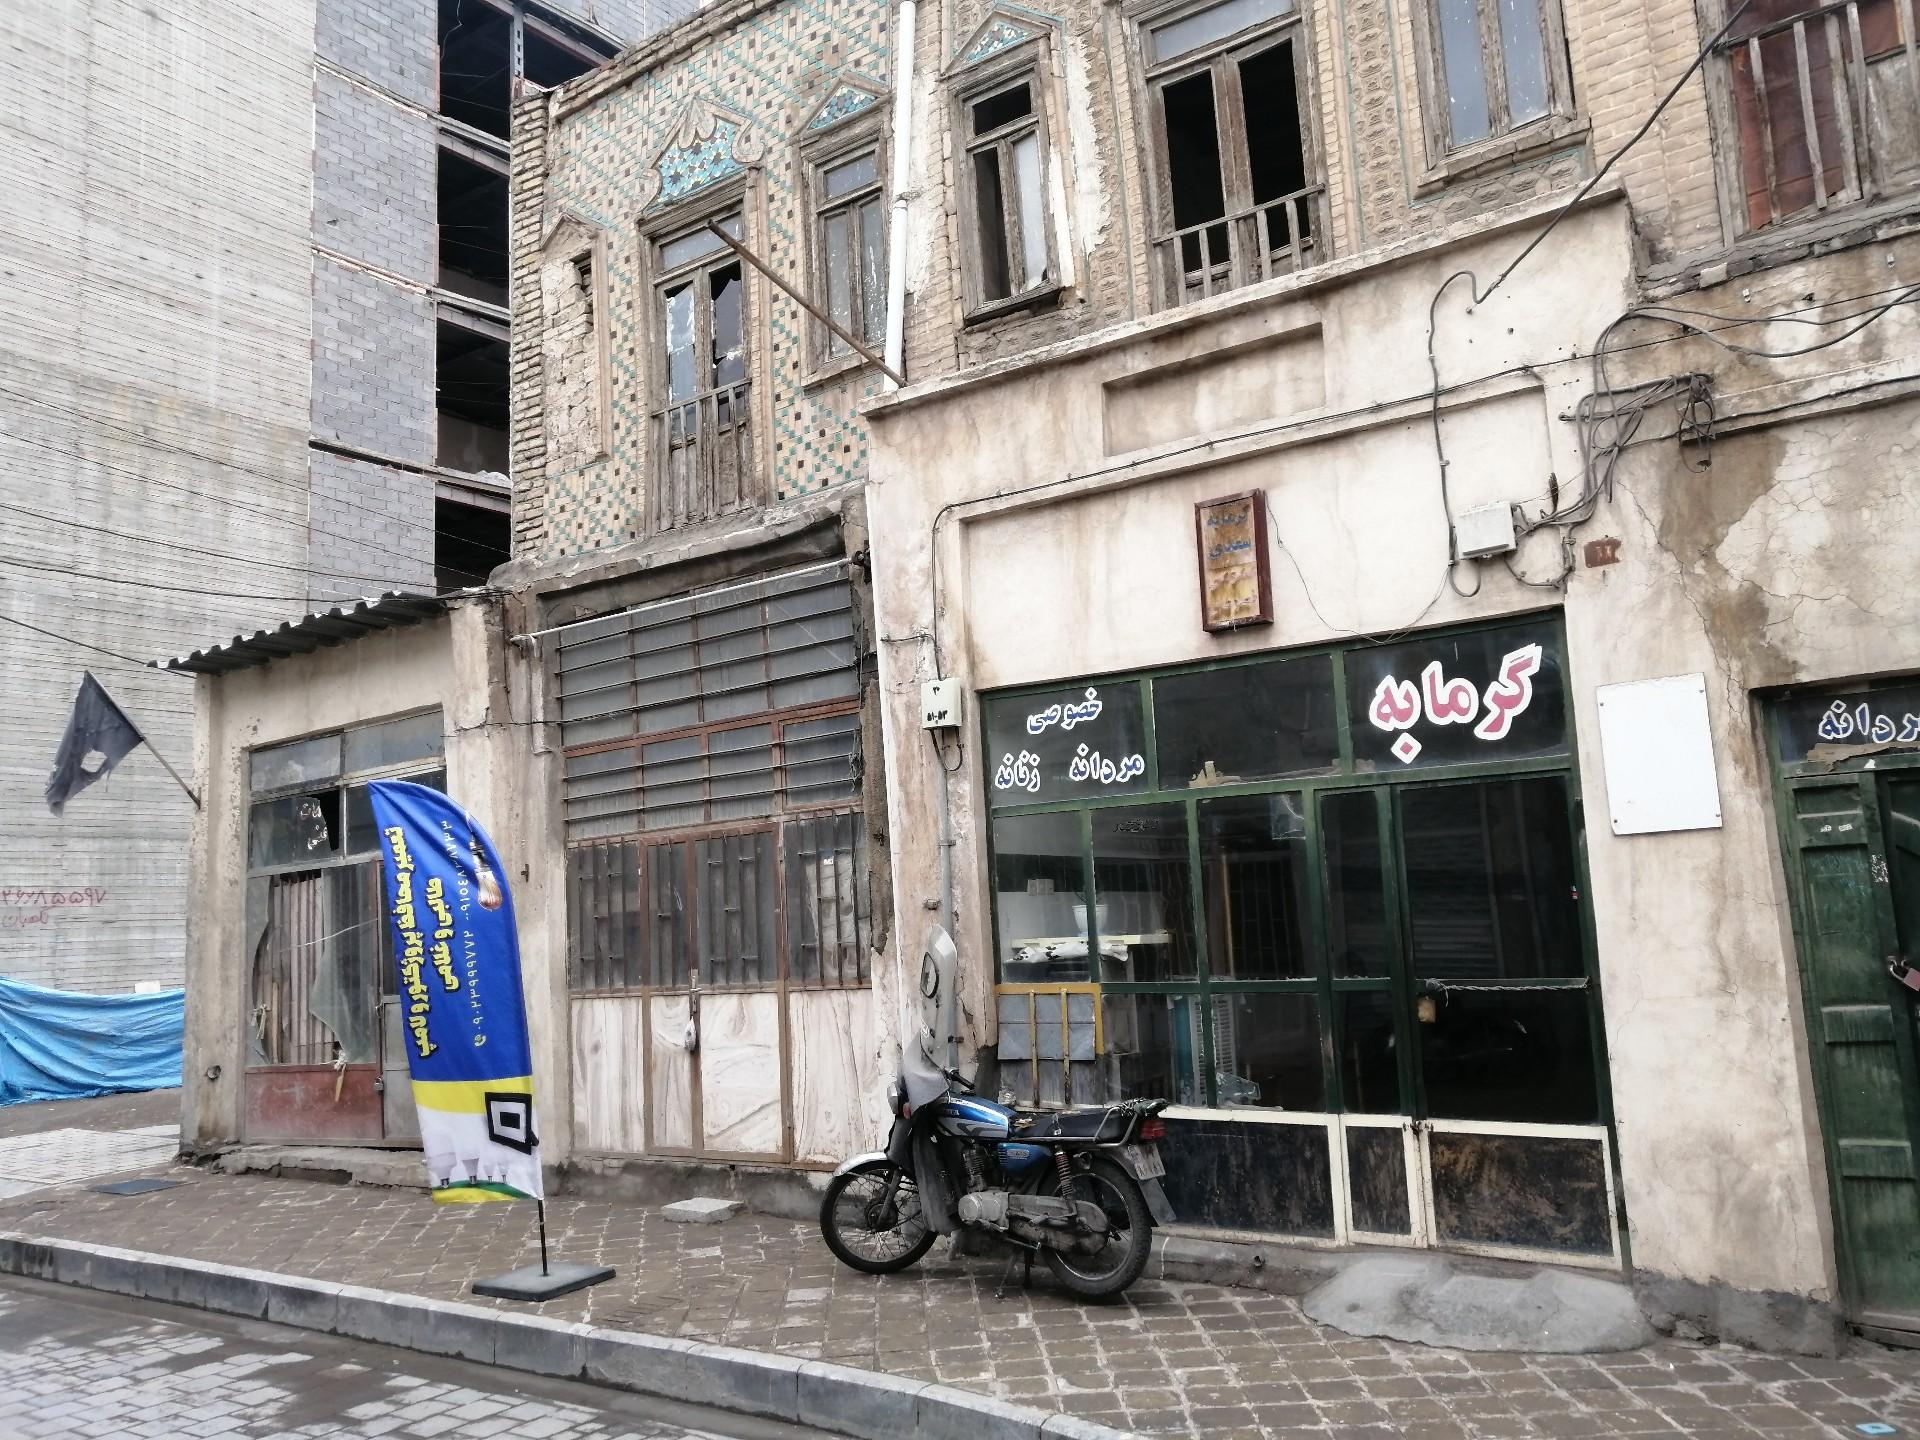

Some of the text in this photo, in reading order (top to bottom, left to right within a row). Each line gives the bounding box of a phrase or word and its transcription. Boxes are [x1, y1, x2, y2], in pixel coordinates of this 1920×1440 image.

[1026, 687, 1102, 734] خصوصی
[1369, 643, 1543, 764] گرمابه
[1818, 700, 1920, 744] ردانه
[995, 743, 1145, 792] مردانه زنانه
[385, 827, 415, 870] تعمیر
[393, 872, 415, 929] محافظ
[426, 877, 460, 991] طالبی و غلامی
[409, 1015, 437, 1057] لامپ
